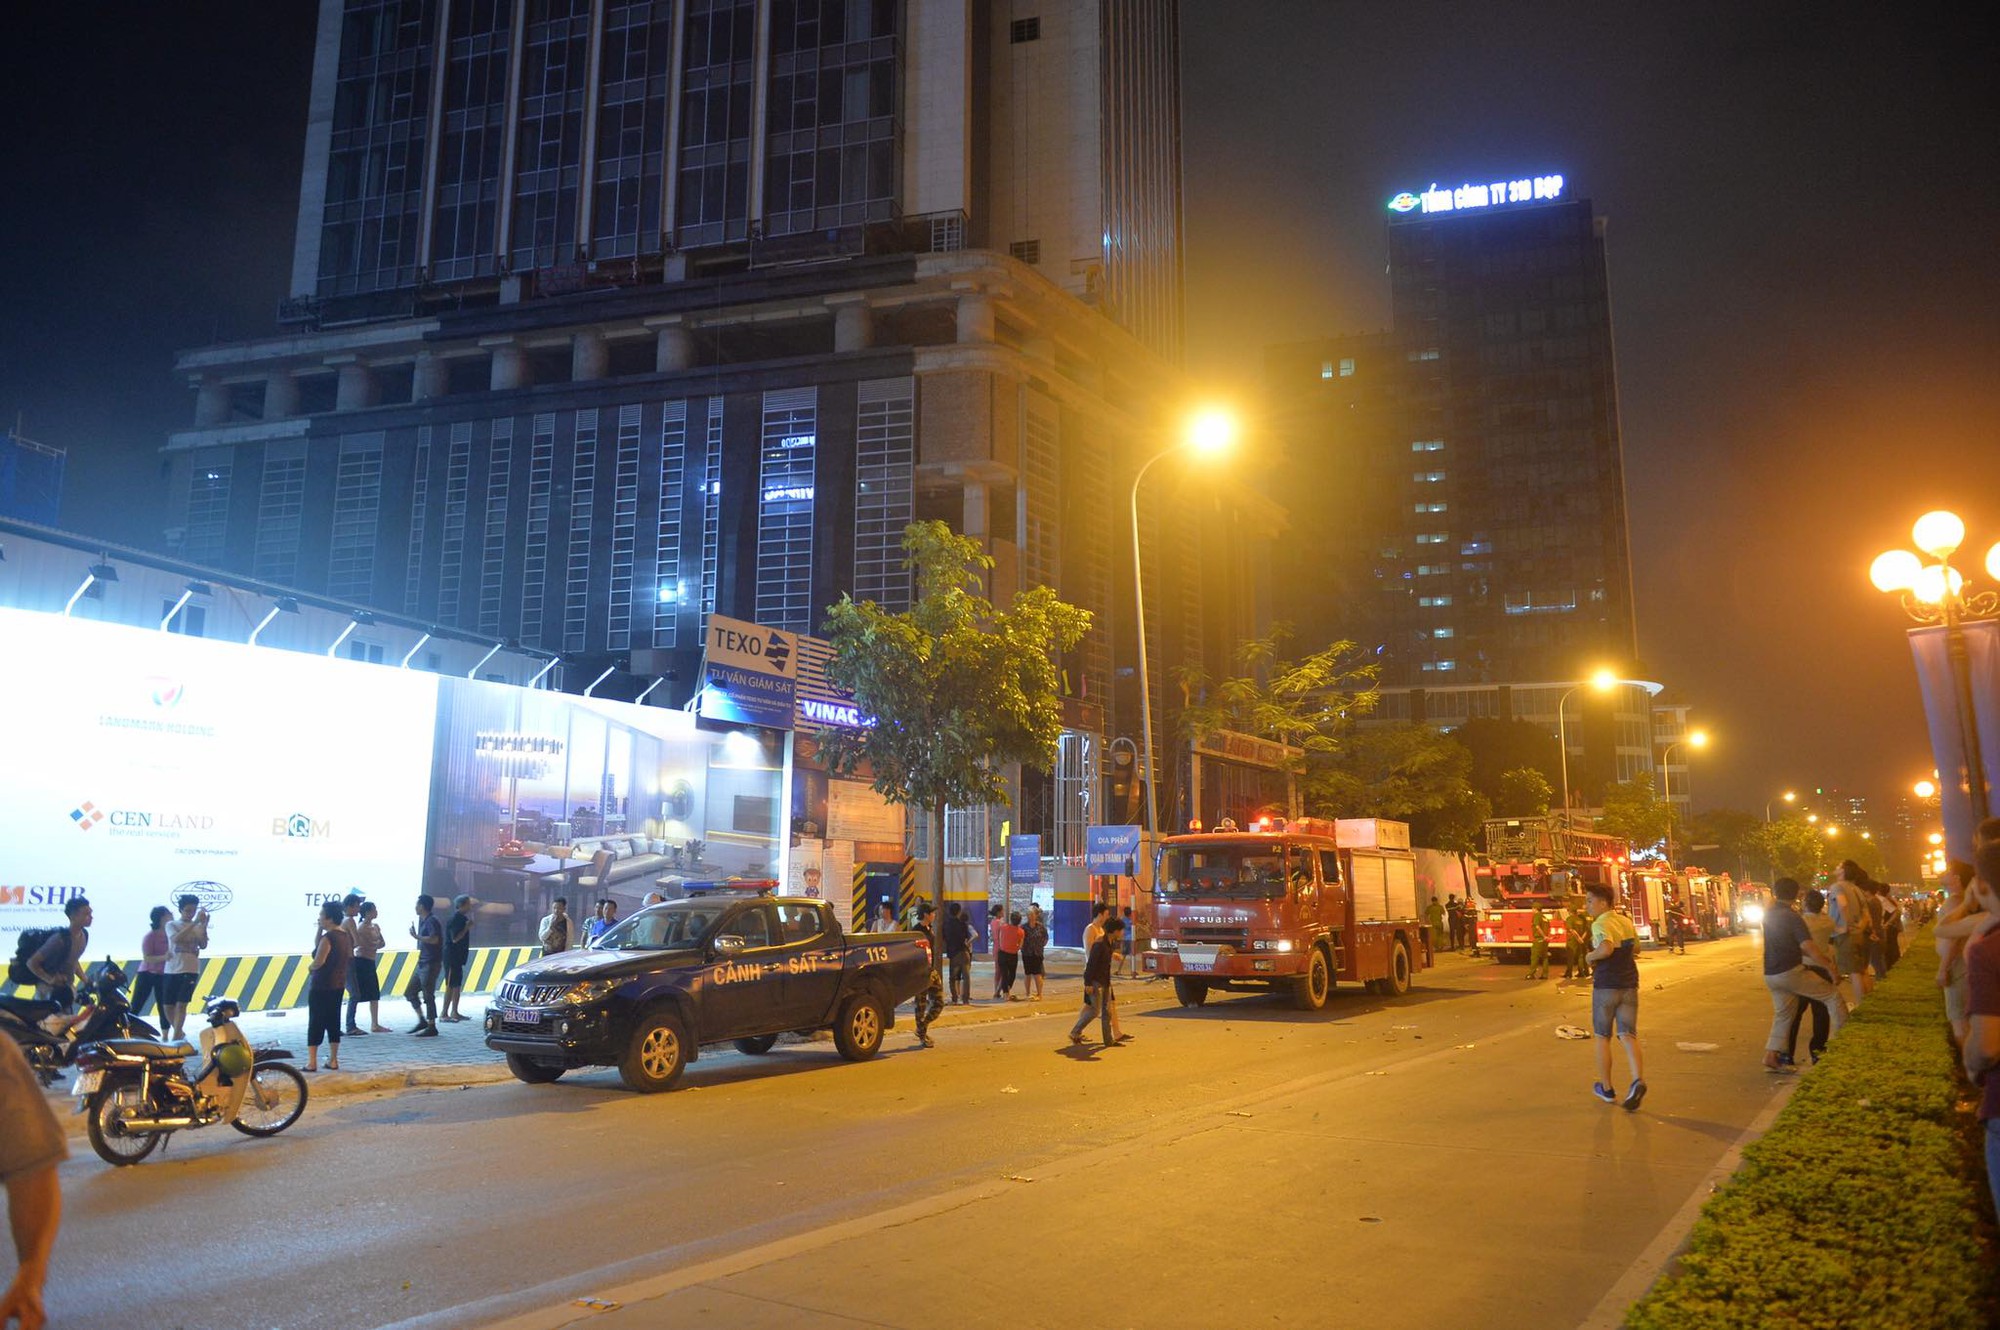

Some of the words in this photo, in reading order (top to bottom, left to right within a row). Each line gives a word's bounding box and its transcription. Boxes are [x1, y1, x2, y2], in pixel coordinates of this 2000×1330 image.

[1490, 182, 1506, 204] TY
[715, 627, 762, 656] TEXO
[110, 810, 152, 828] CEN
[158, 814, 214, 831] LAND
[1180, 916, 1248, 924] MITSUBISHI
[788, 952, 818, 975] SÁT
[866, 946, 888, 962] 113
